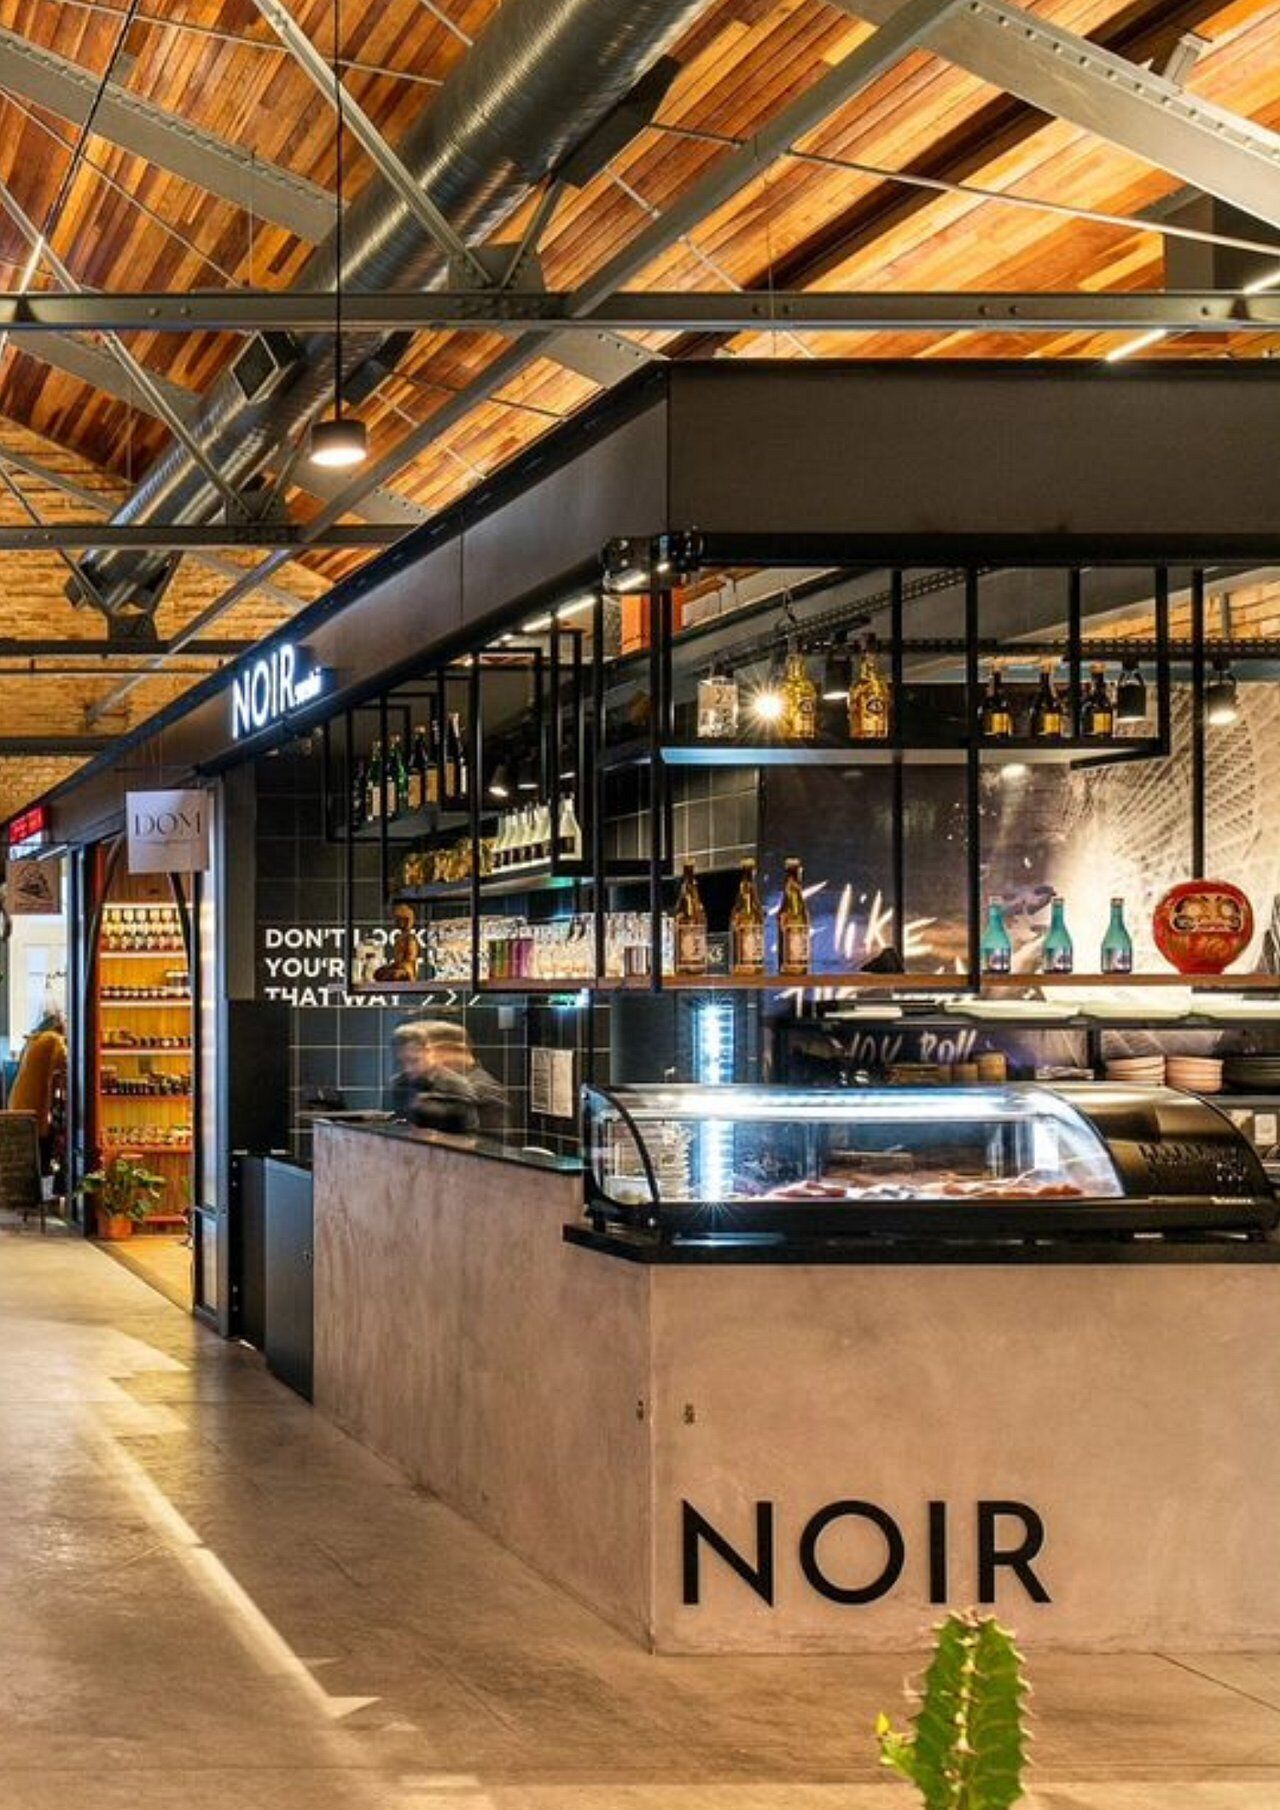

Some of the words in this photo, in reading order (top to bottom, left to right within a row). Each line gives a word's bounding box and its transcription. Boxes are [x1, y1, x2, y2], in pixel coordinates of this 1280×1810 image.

[231, 642, 296, 741] NOIR
[135, 811, 201, 836] DOM
[265, 928, 347, 949] DON'T
[265, 957, 350, 978] YOU'R
[264, 986, 331, 1007] THAT
[681, 1498, 1052, 1607] NOIR
